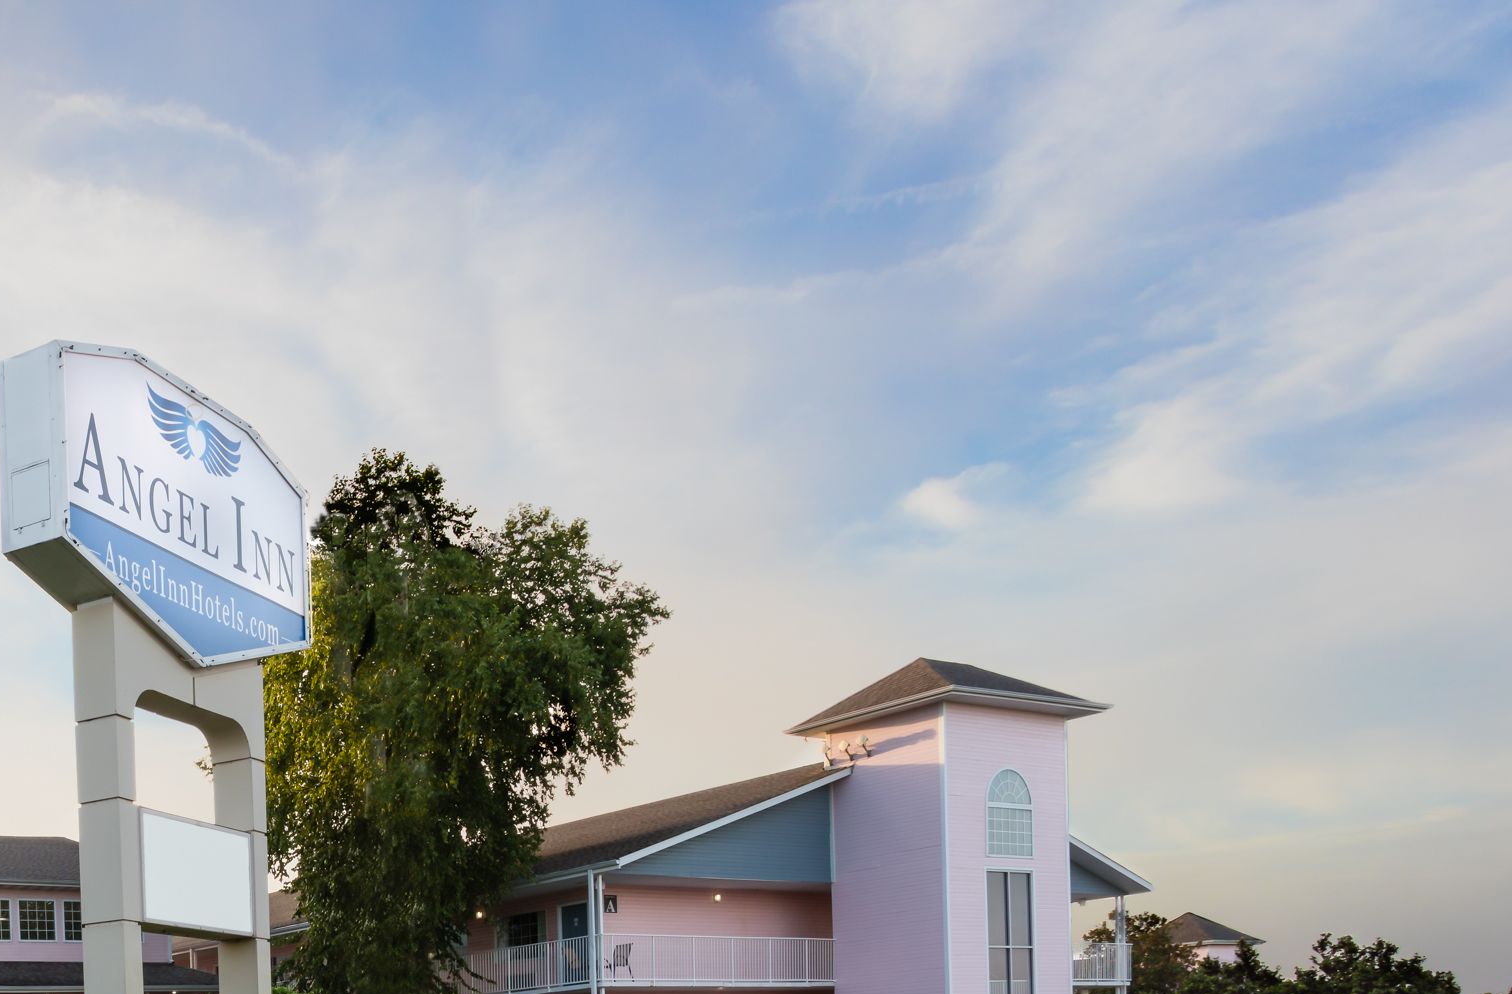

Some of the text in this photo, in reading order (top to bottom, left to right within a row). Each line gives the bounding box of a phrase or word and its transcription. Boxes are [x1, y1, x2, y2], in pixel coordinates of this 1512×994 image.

[73, 412, 295, 598] ANGEL INN
[105, 540, 279, 646] AngelInnHotels.com
[606, 899, 616, 912] A
